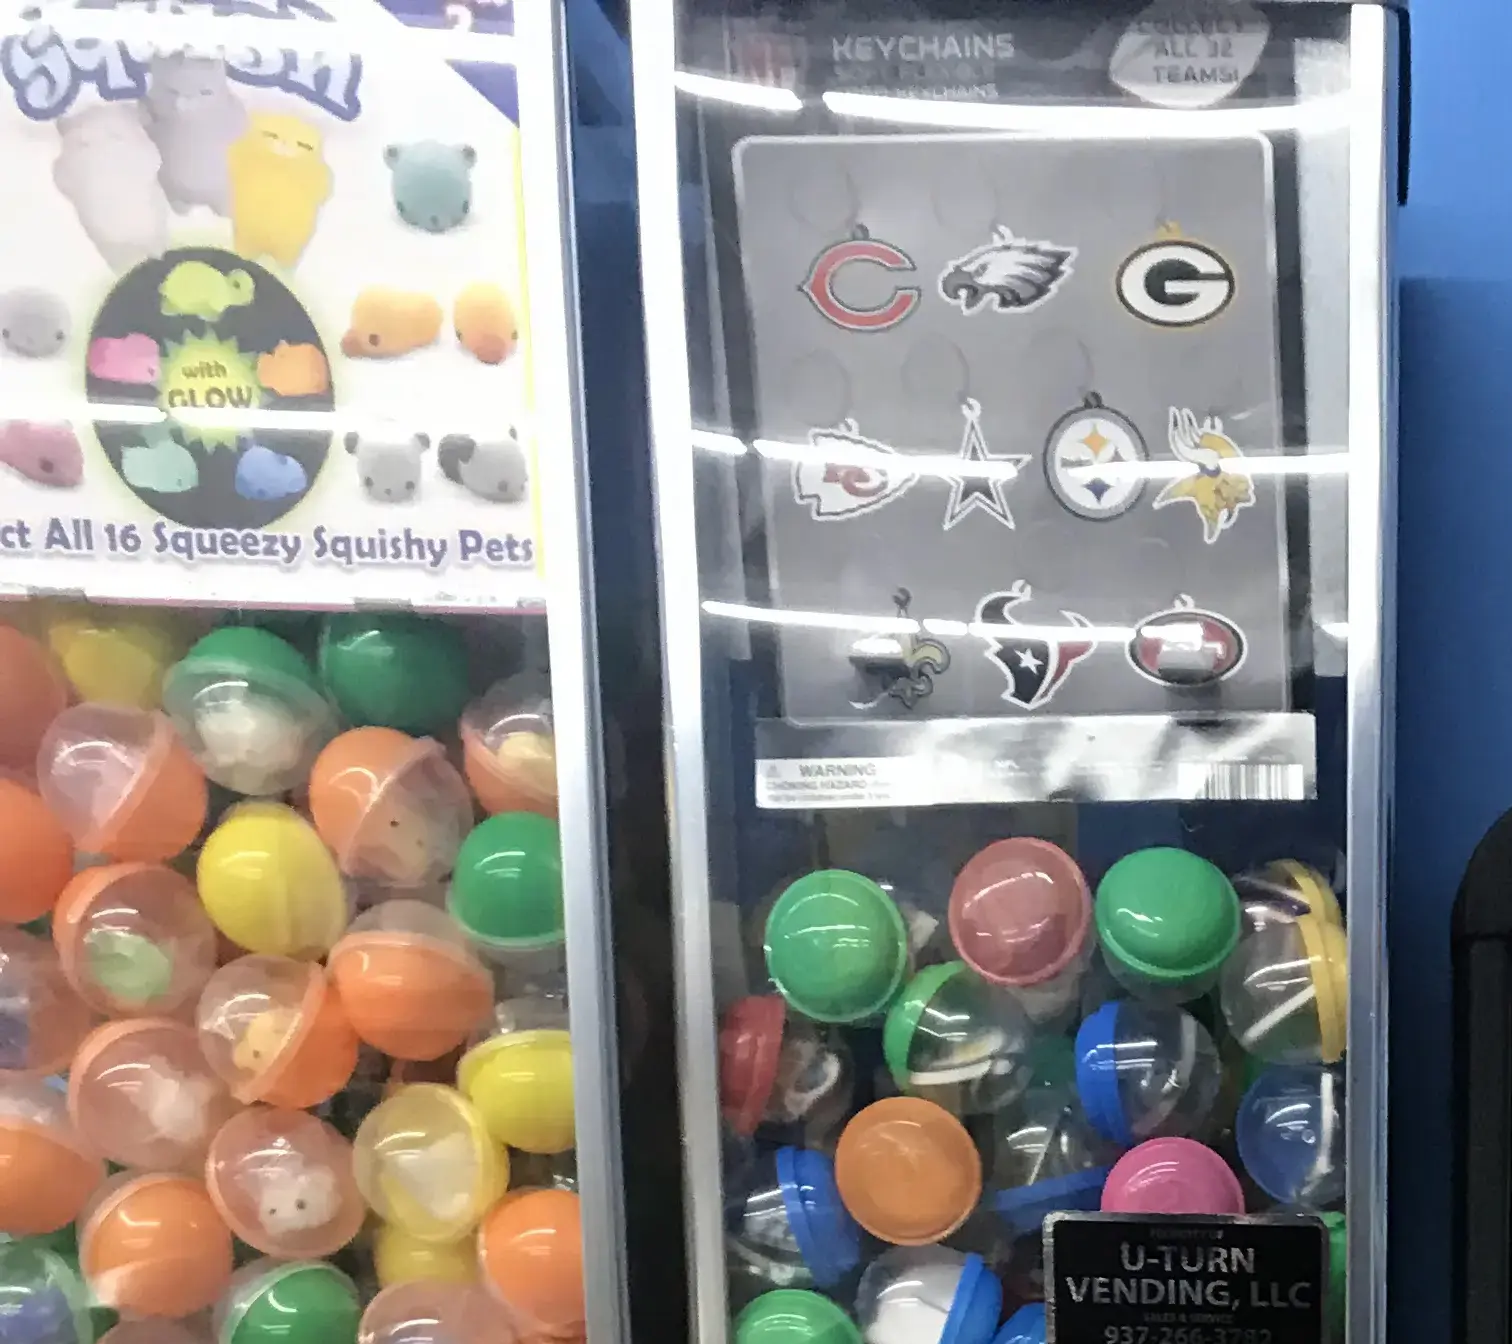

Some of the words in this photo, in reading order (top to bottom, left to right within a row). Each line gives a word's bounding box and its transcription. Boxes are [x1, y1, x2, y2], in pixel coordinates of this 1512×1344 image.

[831, 34, 1014, 60] KEYCHAINS
[1153, 65, 1238, 83] TEAMS!
[181, 360, 228, 380] with
[167, 386, 254, 410] GLOW
[44, 517, 93, 552] All
[106, 523, 142, 553] 16
[154, 522, 302, 564] Squeezy
[313, 525, 448, 568] Squishy
[458, 528, 533, 563] Pets
[800, 763, 877, 778] WARNING
[1119, 1241, 1256, 1273] U-TURN
[1066, 1276, 1241, 1311] VENDING,
[1250, 1281, 1312, 1309] LLC
